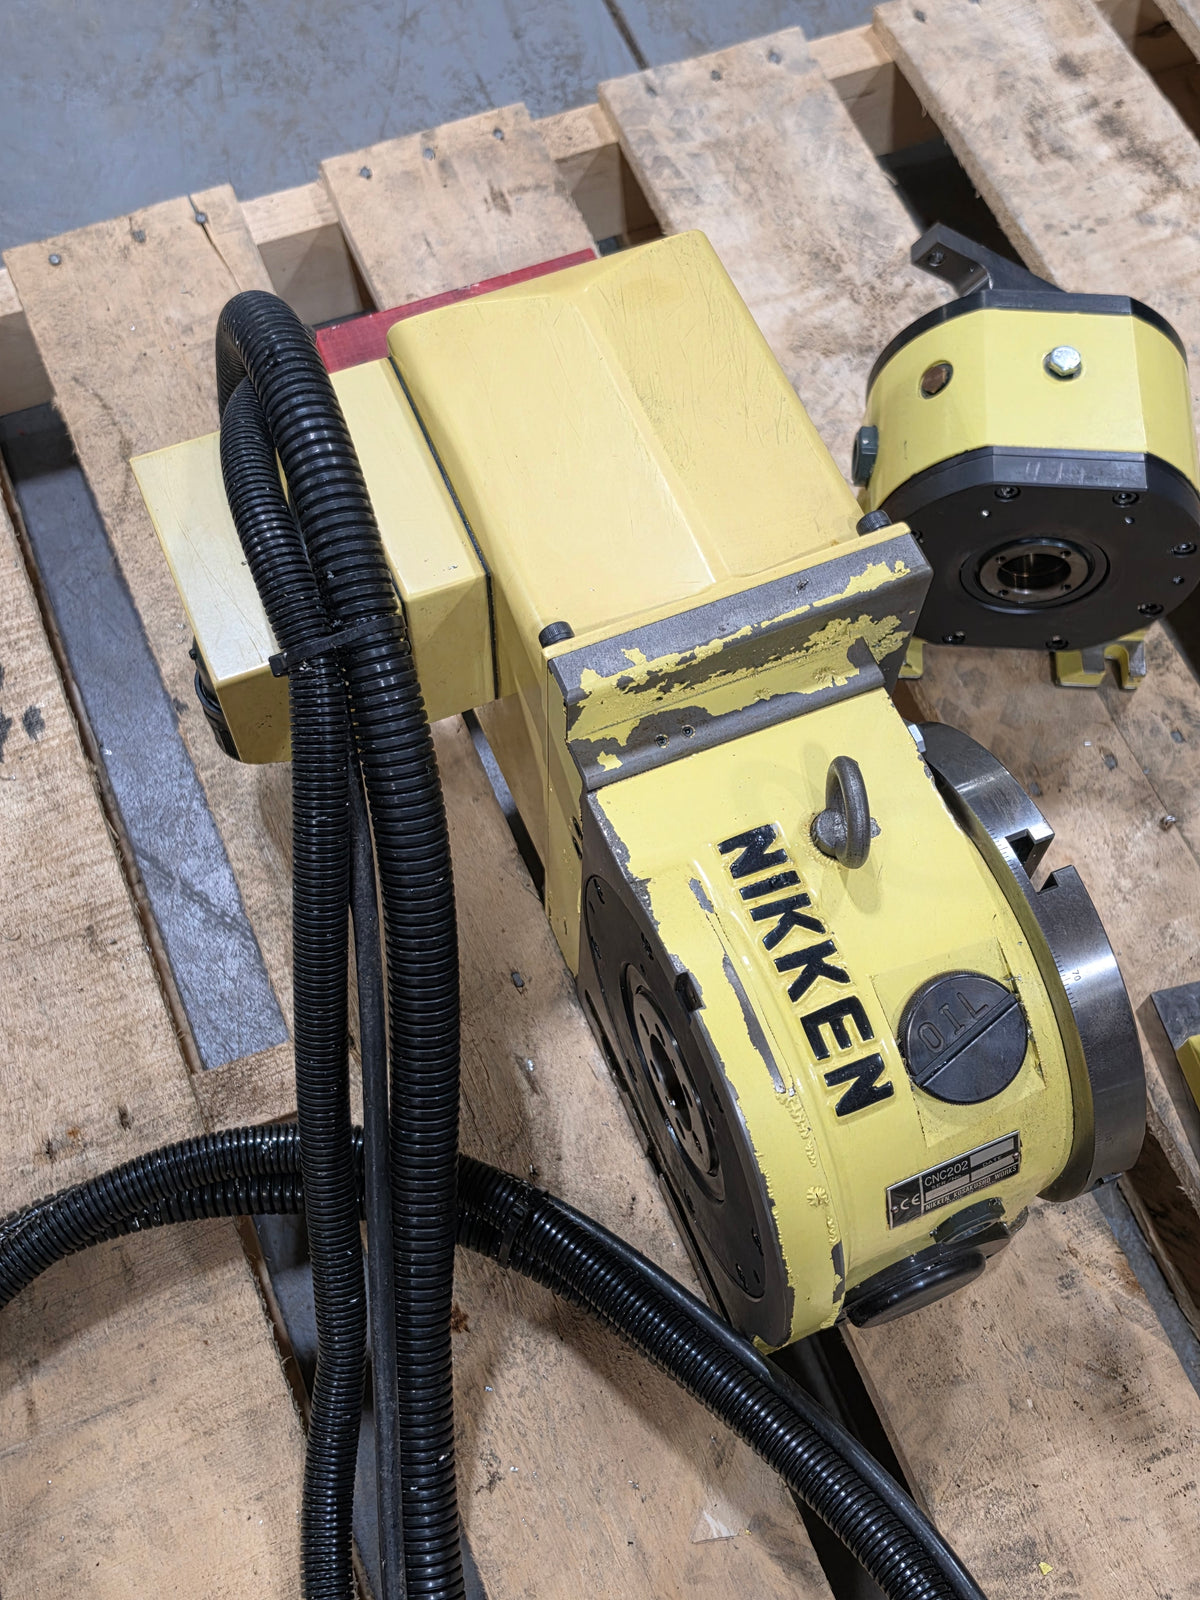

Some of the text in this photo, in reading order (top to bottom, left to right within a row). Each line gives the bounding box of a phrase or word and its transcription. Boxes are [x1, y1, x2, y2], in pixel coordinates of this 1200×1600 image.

[717, 824, 895, 1117] NIKKEN
[1072, 969, 1082, 981] 70
[917, 991, 989, 1053] OIL
[924, 1160, 969, 1186] CNC202
[925, 1195, 950, 1211] NIKKEN
[994, 1165, 1017, 1180] WORKS
[900, 1193, 921, 1210] CE
